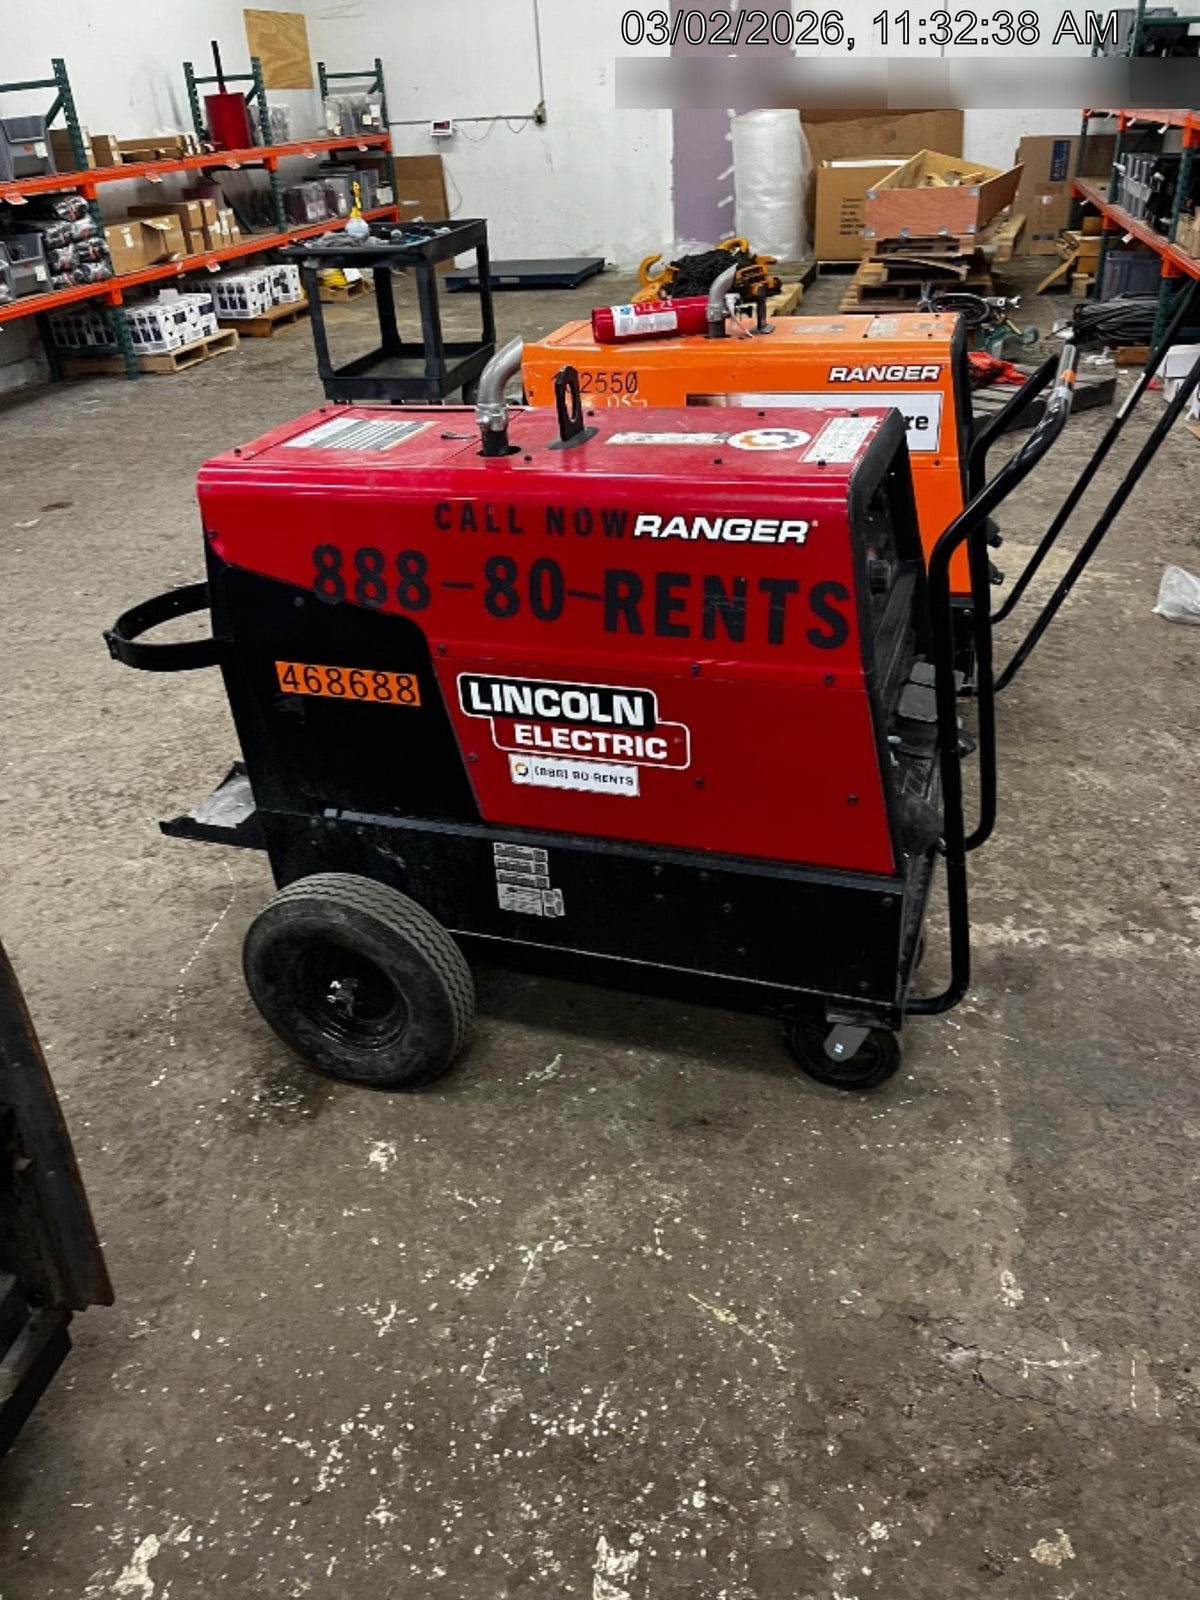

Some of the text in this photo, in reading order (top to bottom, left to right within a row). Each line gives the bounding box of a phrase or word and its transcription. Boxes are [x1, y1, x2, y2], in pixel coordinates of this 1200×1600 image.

[828, 364, 940, 382] RANGER
[435, 502, 629, 537] CALL NOW
[633, 513, 808, 544] RANGER
[312, 543, 851, 650] 888-80-RENTS
[282, 664, 417, 703] 468688
[469, 681, 645, 726] LINCOLN
[514, 723, 668, 760] ELECTRIC
